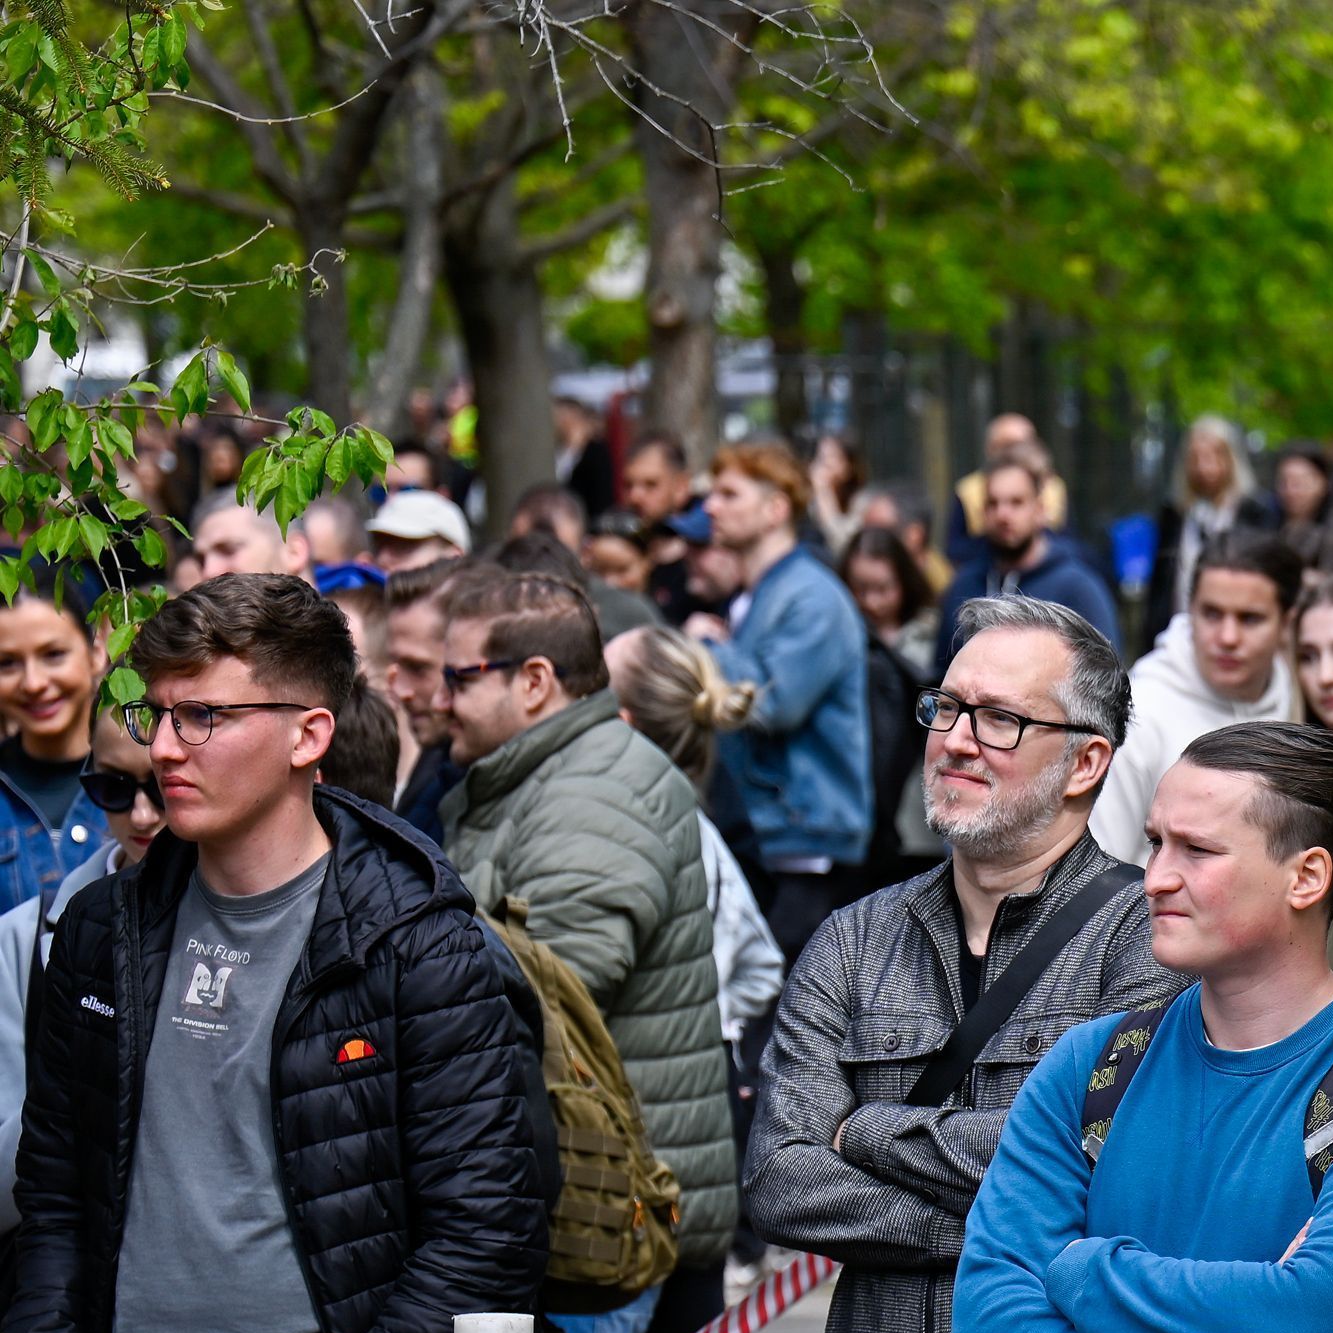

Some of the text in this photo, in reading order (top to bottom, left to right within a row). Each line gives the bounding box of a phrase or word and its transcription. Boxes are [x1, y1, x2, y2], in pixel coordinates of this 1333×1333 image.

[186, 938, 250, 965] PINK FLOYD
[81, 994, 115, 1018] ellesse
[184, 1018, 215, 1030] DIVISION
